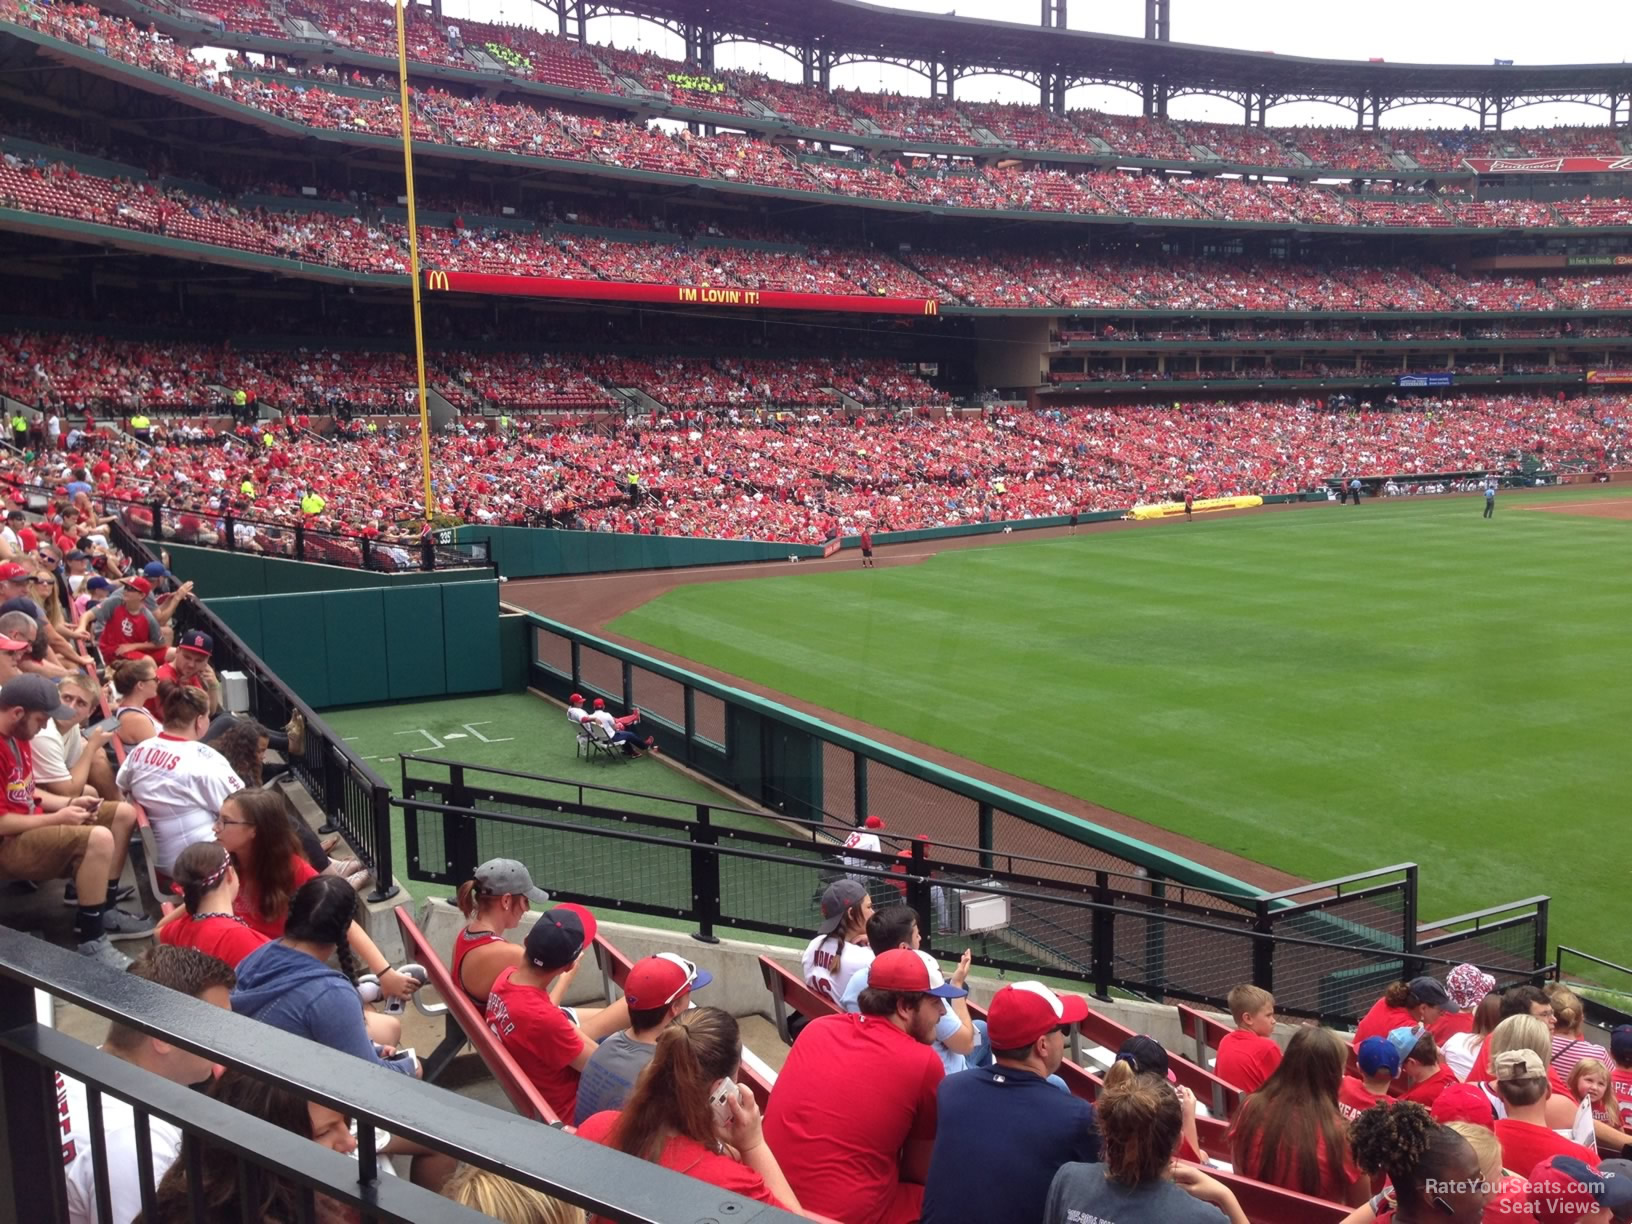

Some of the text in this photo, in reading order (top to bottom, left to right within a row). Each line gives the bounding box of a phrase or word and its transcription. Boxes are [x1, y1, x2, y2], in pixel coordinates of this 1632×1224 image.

[679, 287, 759, 304] I'M LOVIN' IT!
[440, 530, 452, 544] 335
[144, 748, 181, 771] LOUIS
